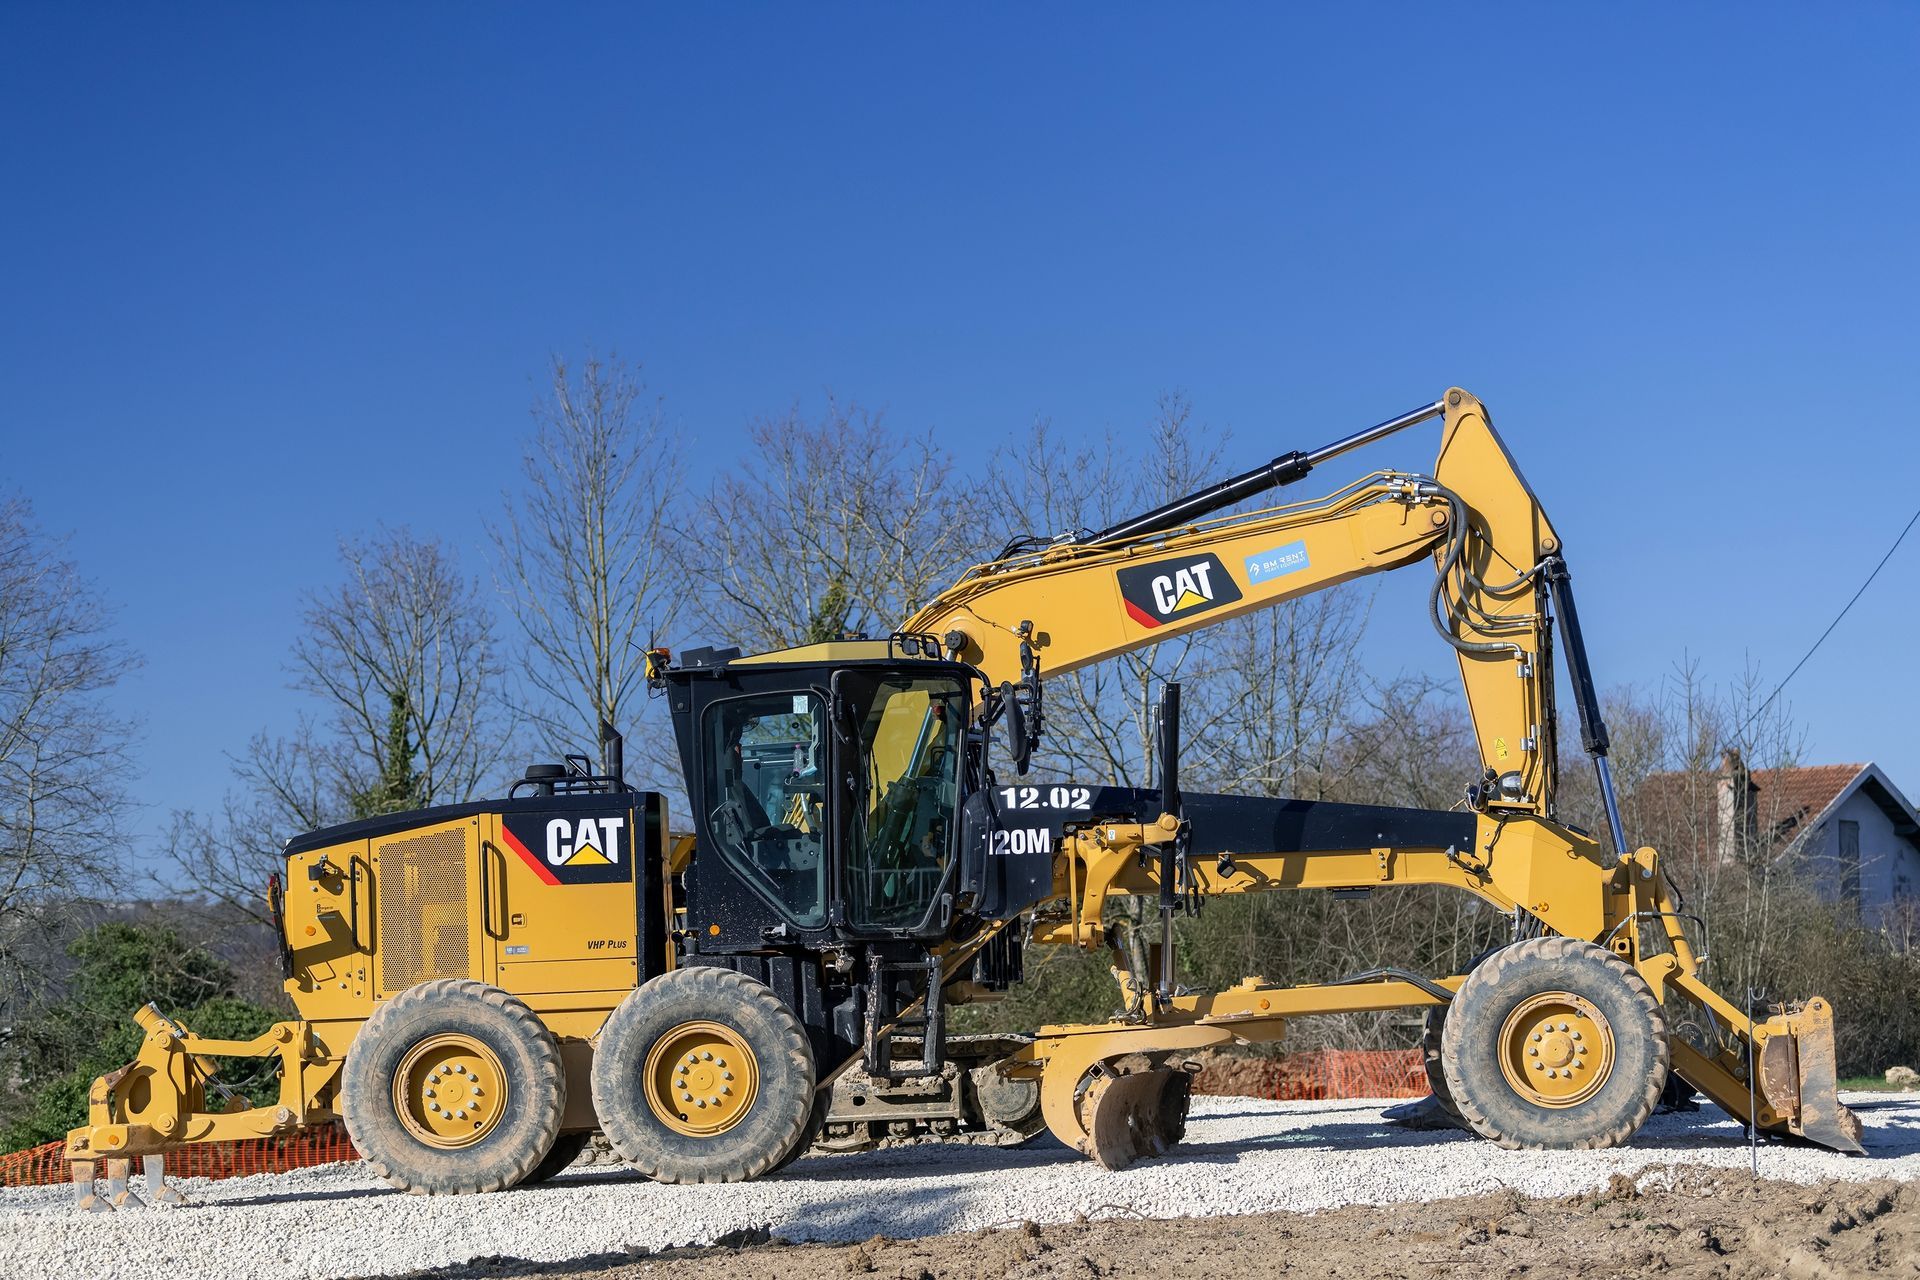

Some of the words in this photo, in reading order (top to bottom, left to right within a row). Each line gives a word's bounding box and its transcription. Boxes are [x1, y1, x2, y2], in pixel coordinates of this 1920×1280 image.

[1263, 560, 1277, 569] BM
[1279, 550, 1304, 563] RENT
[1151, 561, 1214, 615] CAT
[1000, 787, 1091, 810] 12.02
[546, 817, 624, 866] CAT
[587, 940, 605, 950] VHP
